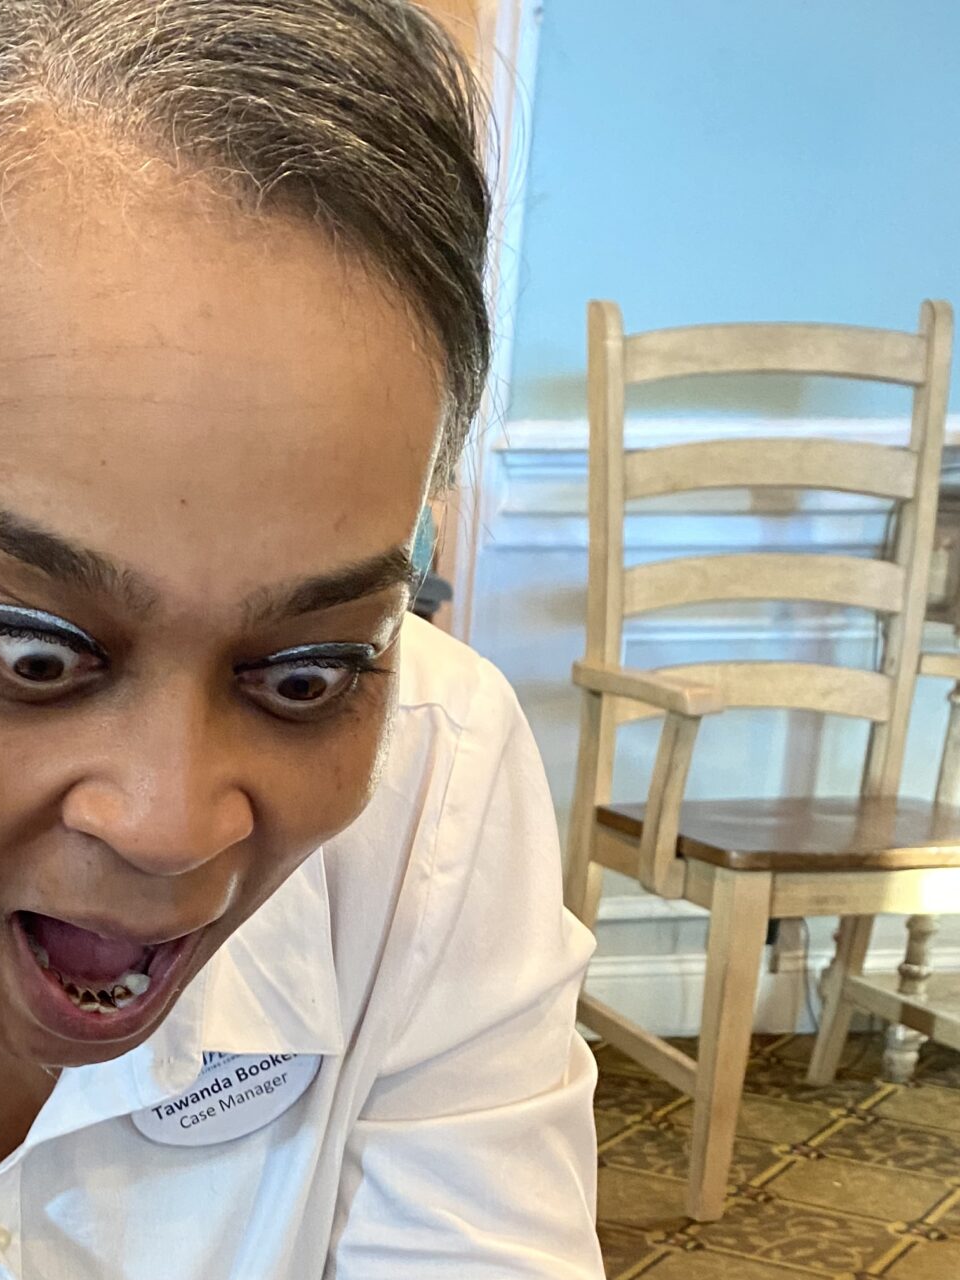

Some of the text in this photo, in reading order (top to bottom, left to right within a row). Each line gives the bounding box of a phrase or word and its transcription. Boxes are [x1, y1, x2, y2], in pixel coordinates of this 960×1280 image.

[152, 1077, 232, 1120] Tawanda
[180, 1072, 288, 1129] Case Manager
